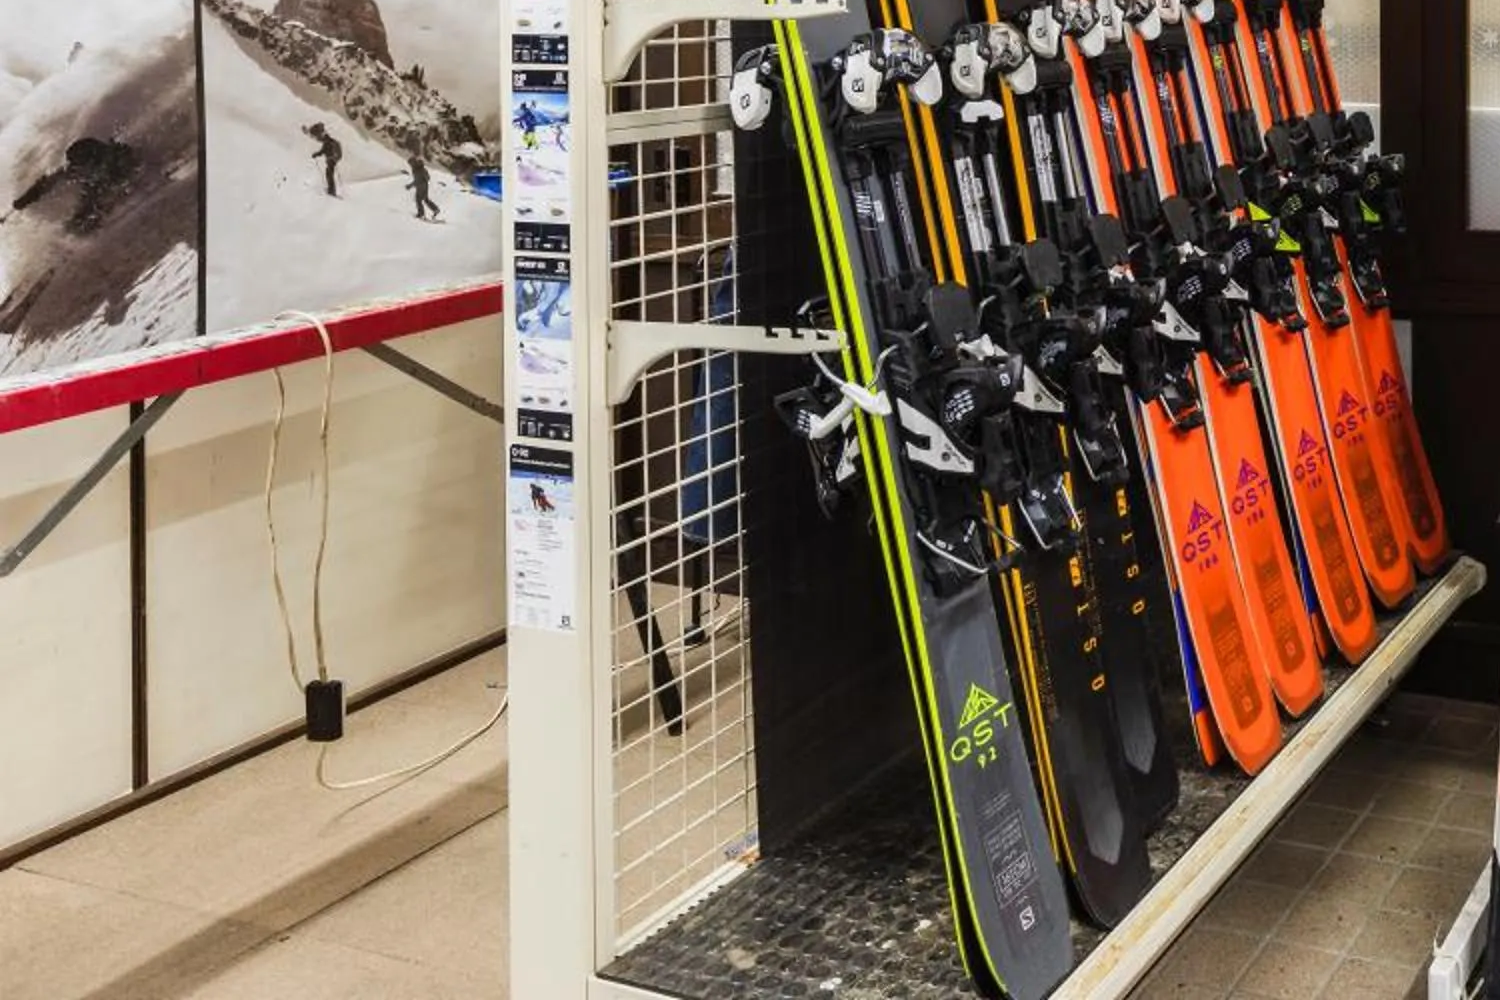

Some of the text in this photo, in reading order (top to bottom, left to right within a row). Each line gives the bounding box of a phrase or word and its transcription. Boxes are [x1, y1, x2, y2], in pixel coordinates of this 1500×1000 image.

[1334, 406, 1368, 438] QST
[1293, 446, 1327, 481] QST
[1231, 478, 1269, 515] QST
[1182, 518, 1223, 563] QST
[950, 701, 1012, 762] QST
